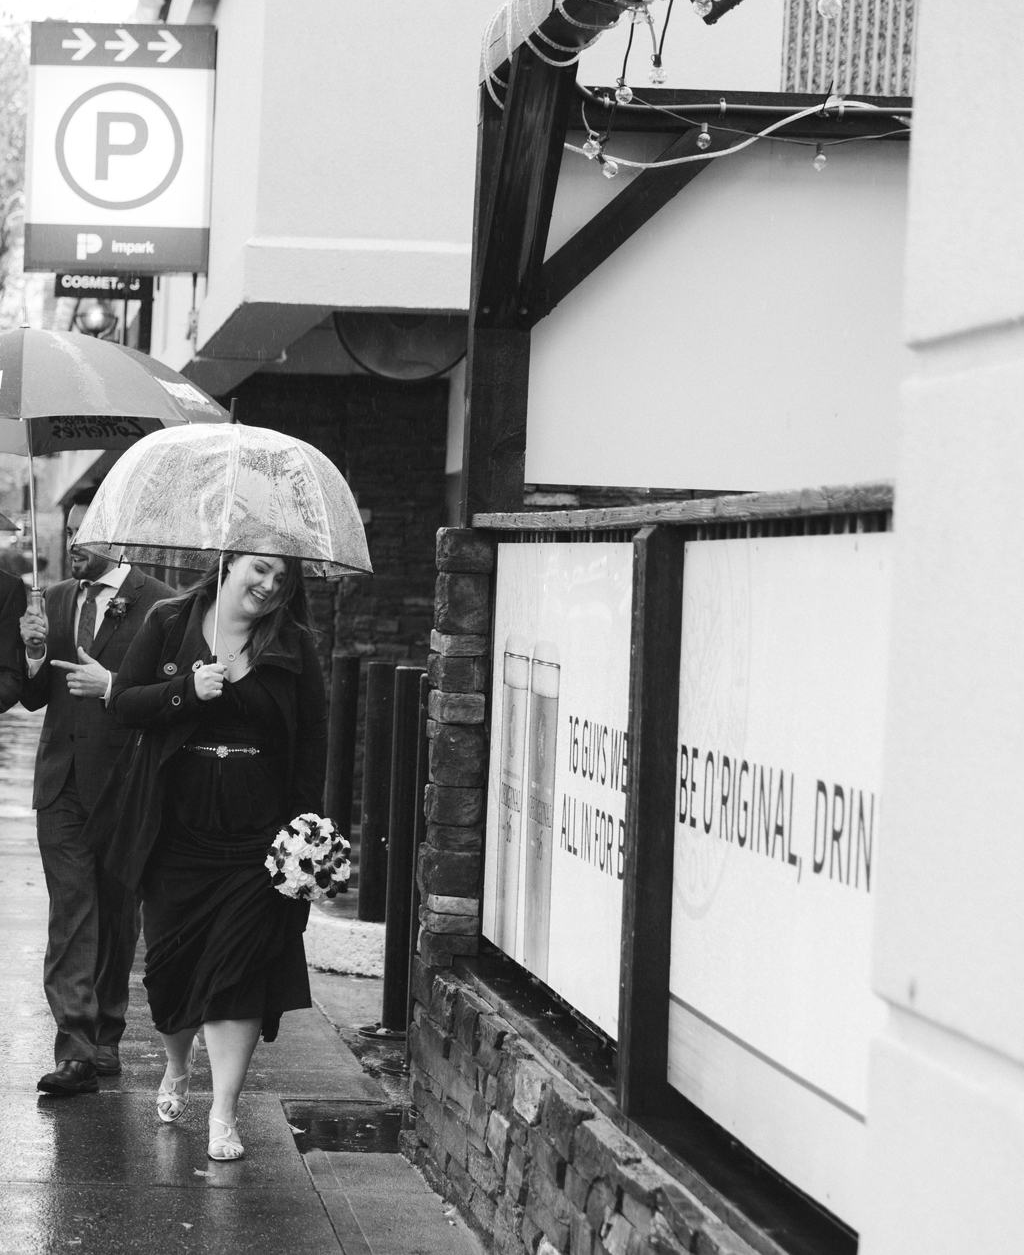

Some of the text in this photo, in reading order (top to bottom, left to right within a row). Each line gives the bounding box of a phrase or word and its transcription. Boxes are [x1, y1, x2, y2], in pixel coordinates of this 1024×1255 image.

[95, 112, 148, 180] P
[112, 240, 154, 256] impark
[582, 720, 608, 786] GUYS
[560, 794, 578, 856] ALL
[581, 802, 592, 863] IN
[594, 808, 614, 876] FOR
